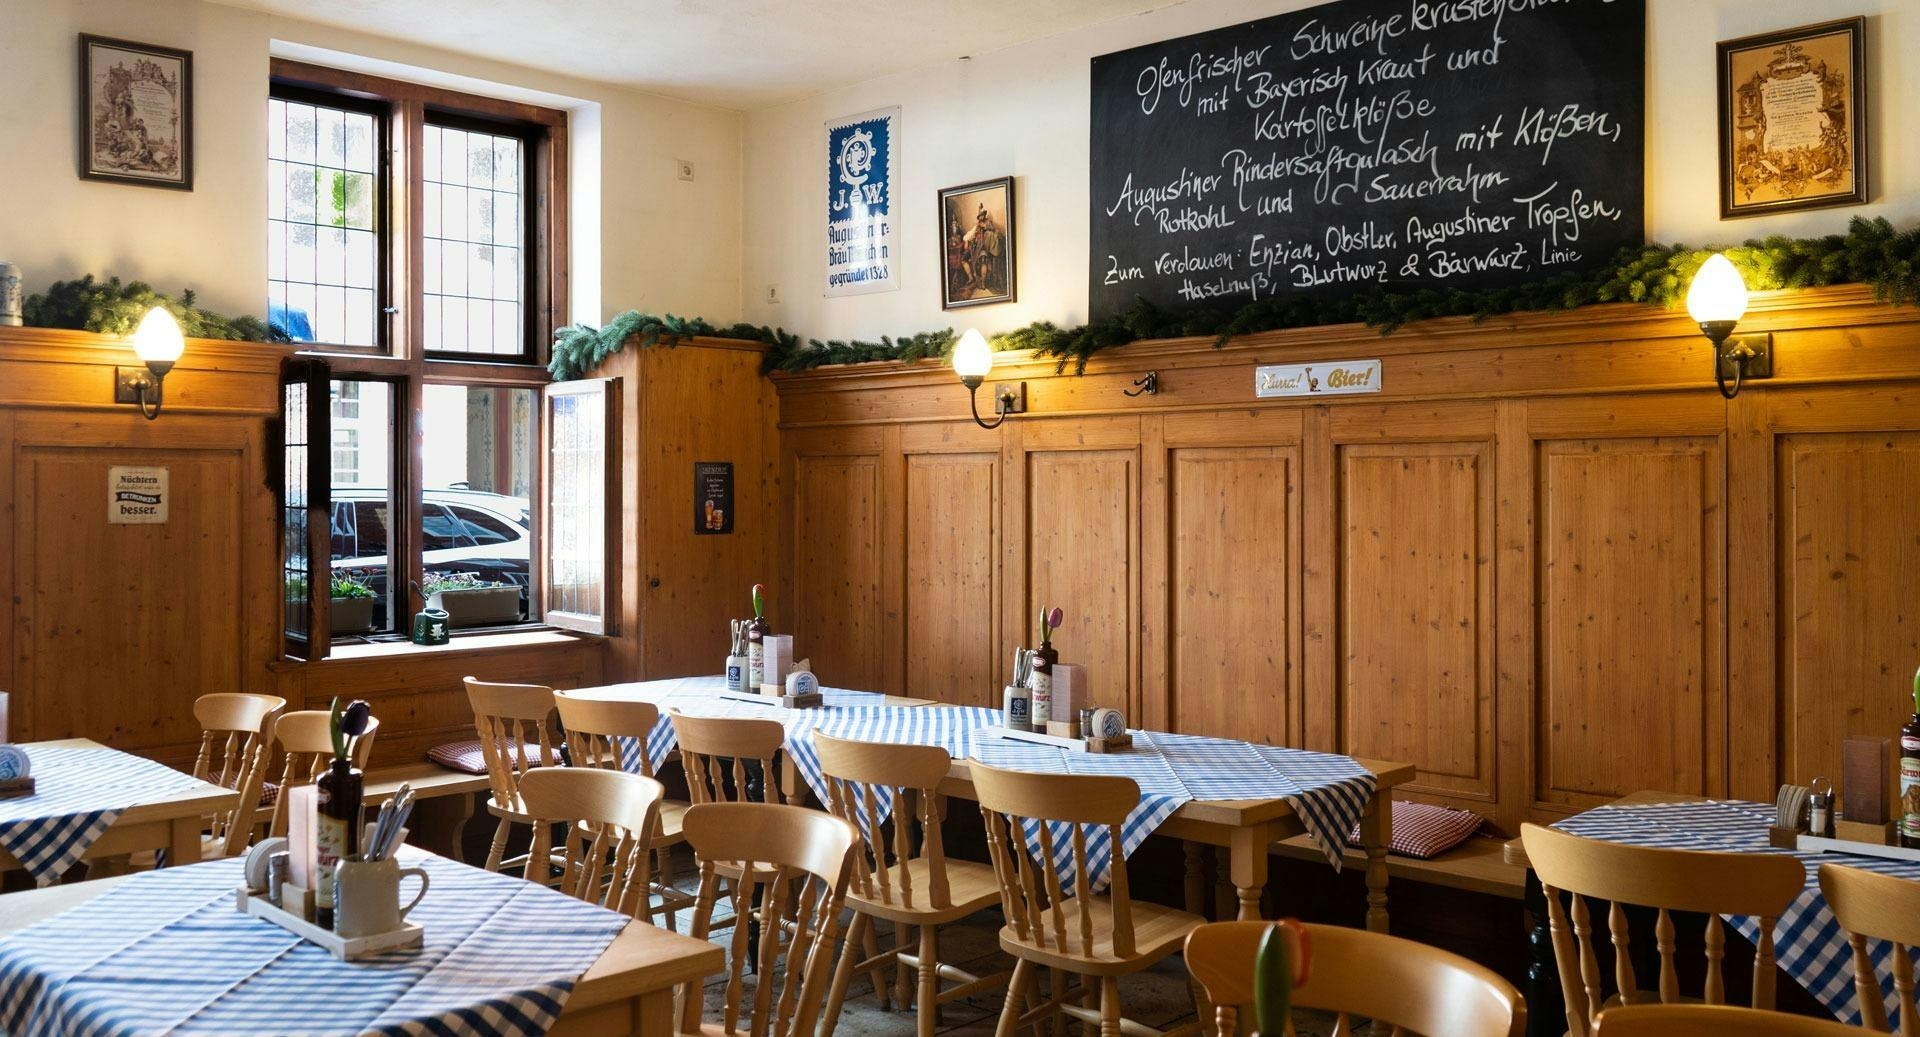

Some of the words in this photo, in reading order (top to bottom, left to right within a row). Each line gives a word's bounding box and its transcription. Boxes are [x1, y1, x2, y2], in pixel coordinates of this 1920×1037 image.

[1137, 46, 1272, 115] Ofenfrischer
[1197, 86, 1229, 116] mit
[1247, 66, 1348, 121] Bayerisch
[1357, 43, 1437, 85] Kraut
[1447, 38, 1507, 71] und
[1254, 90, 1437, 166] Kartoffelklöße
[833, 189, 849, 211] J.
[862, 182, 883, 204] W.
[1106, 167, 1222, 226] Augustiner
[1221, 130, 1439, 212] Rindersaftgulasch
[1456, 114, 1503, 151] mit
[1513, 104, 1621, 166] Klößen,
[1154, 204, 1235, 234] Rotkohl
[1257, 188, 1293, 216] und
[1364, 163, 1510, 204] Sauerrahm
[829, 246, 848, 267] Bräu
[1104, 254, 1144, 285] Zum
[1249, 233, 1320, 277] Enzian,
[1406, 206, 1515, 250] Augustiner
[1513, 181, 1622, 246] Tropfen,
[829, 267, 869, 289] gegründet
[869, 264, 889, 280] 1328
[1178, 272, 1277, 301] Haselnuß,
[1290, 260, 1388, 288] Blutwurz
[1399, 253, 1420, 277] &
[1428, 242, 1531, 278] Bärwurz,
[1541, 238, 1582, 265] Linie
[1327, 367, 1373, 388] Bier!
[120, 505, 157, 515] besser.
